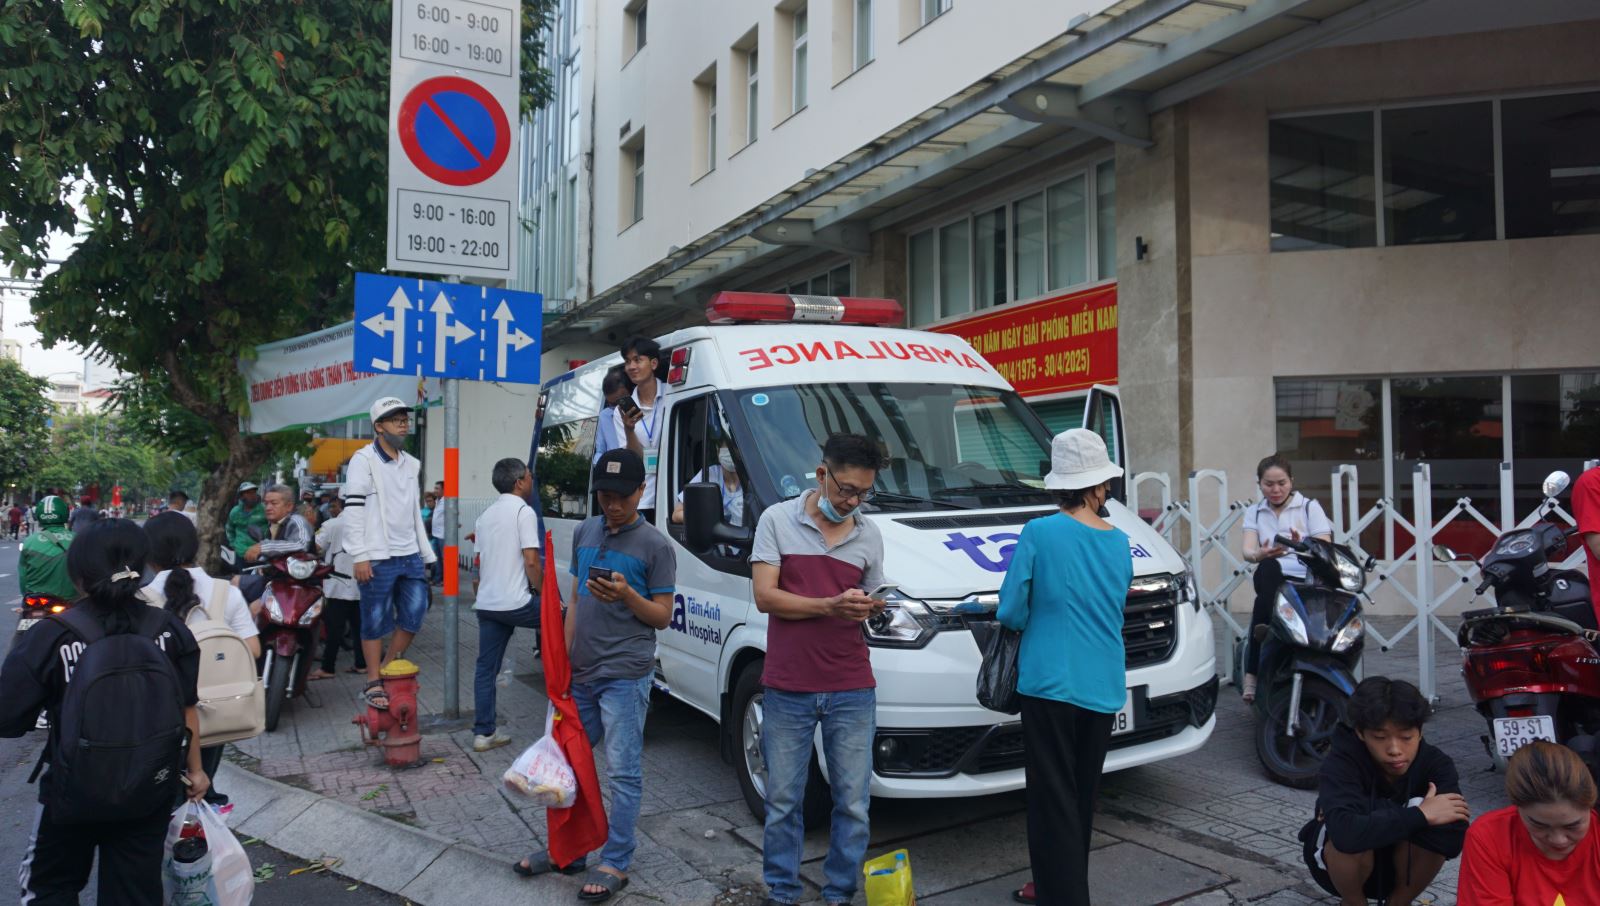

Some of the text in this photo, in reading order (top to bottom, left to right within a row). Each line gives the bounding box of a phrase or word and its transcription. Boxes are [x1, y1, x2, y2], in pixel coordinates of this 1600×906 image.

[417, 3, 450, 24] 6:00
[467, 12, 499, 34] 9:00
[412, 33, 449, 55] 16:00
[468, 43, 503, 65] 19:00
[413, 202, 444, 222] 9:00
[460, 207, 496, 227] 16:00
[408, 233, 445, 254] 19:00
[461, 239, 500, 258] 22:00
[984, 329, 1000, 354] NĂM
[1002, 323, 1021, 350] NGÀY
[1023, 316, 1039, 346] GIẢI
[1041, 312, 1070, 343] PHÓNG
[1071, 302, 1095, 337] MIỀN
[1097, 304, 1117, 332] NAM
[1044, 347, 1090, 377] 30/4/2025)
[40, 512, 58, 520] Grab
[687, 596, 721, 622] Tâm Anh
[688, 619, 722, 646] Hospital
